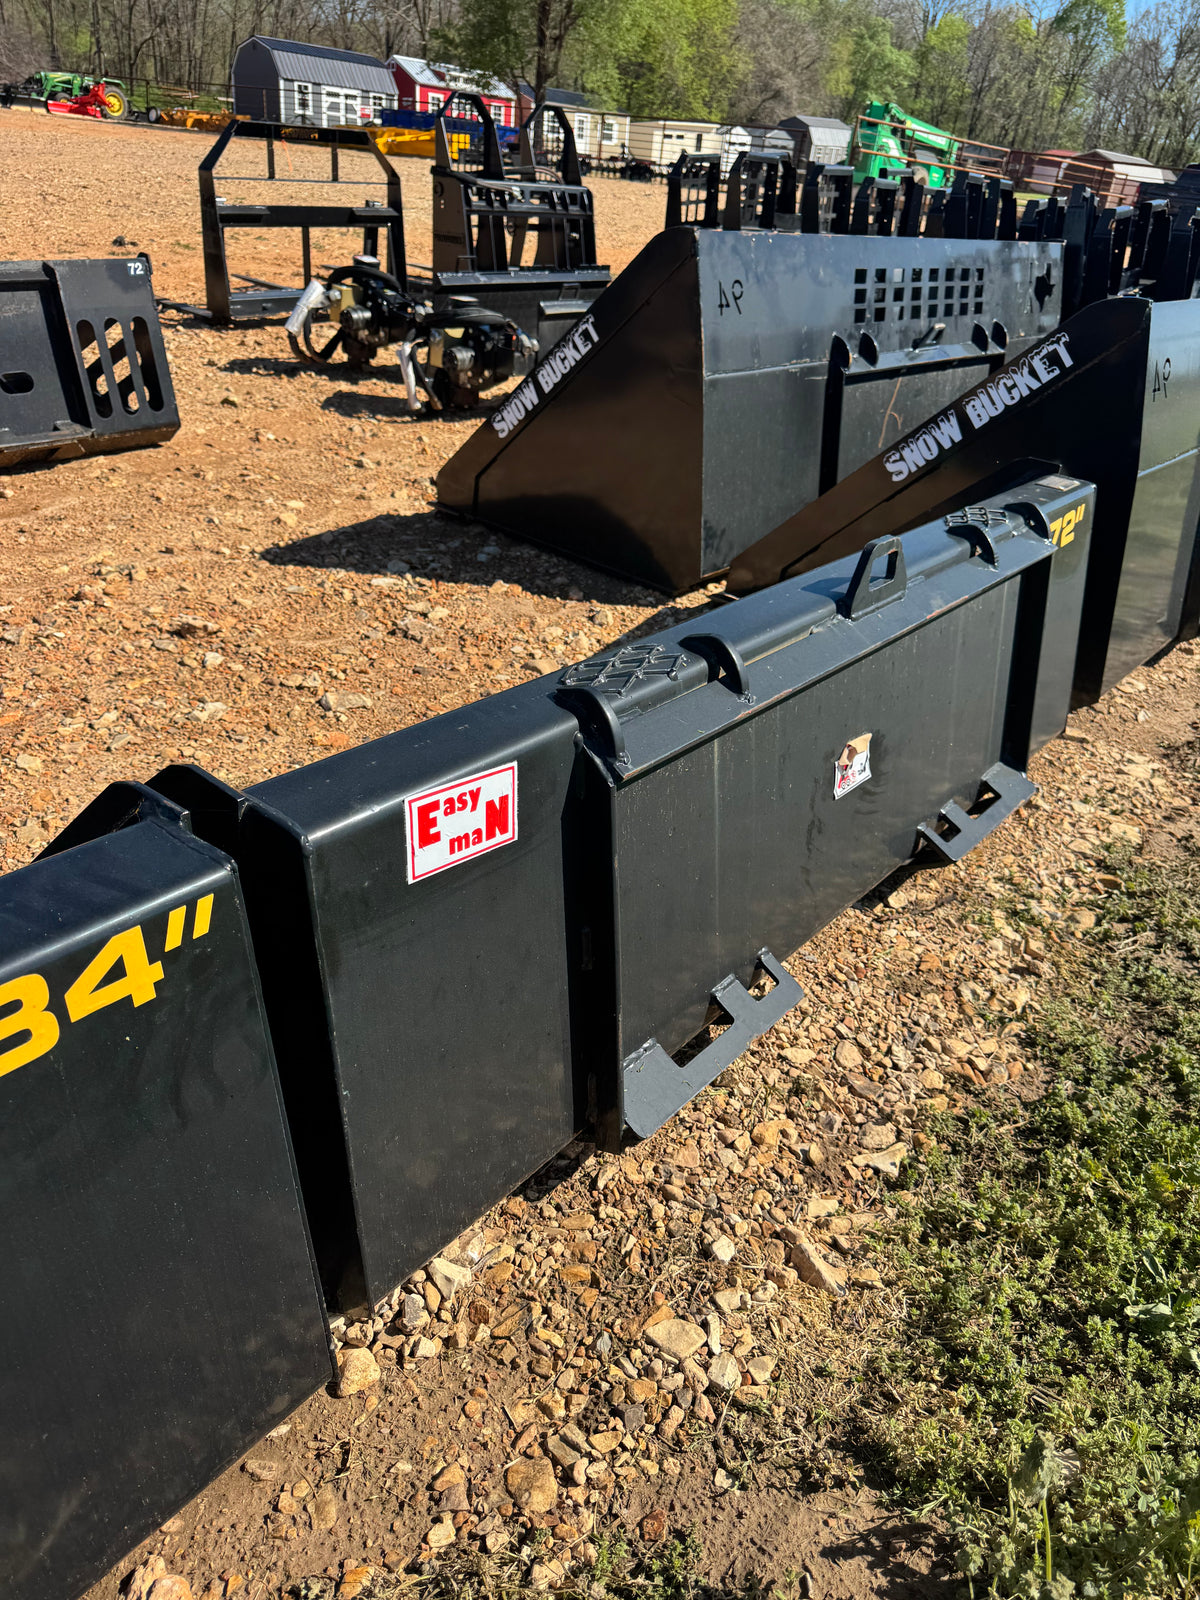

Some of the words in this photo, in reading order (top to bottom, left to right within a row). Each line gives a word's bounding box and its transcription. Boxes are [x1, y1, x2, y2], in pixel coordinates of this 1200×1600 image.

[127, 262, 145, 275] 72
[491, 377, 539, 439] SNOW
[534, 313, 600, 394] BUCKET
[882, 409, 963, 482] SNOW
[962, 331, 1074, 430] BUCKET
[1049, 503, 1086, 548] 72"
[417, 786, 482, 849] Easy
[449, 794, 509, 855] maN
